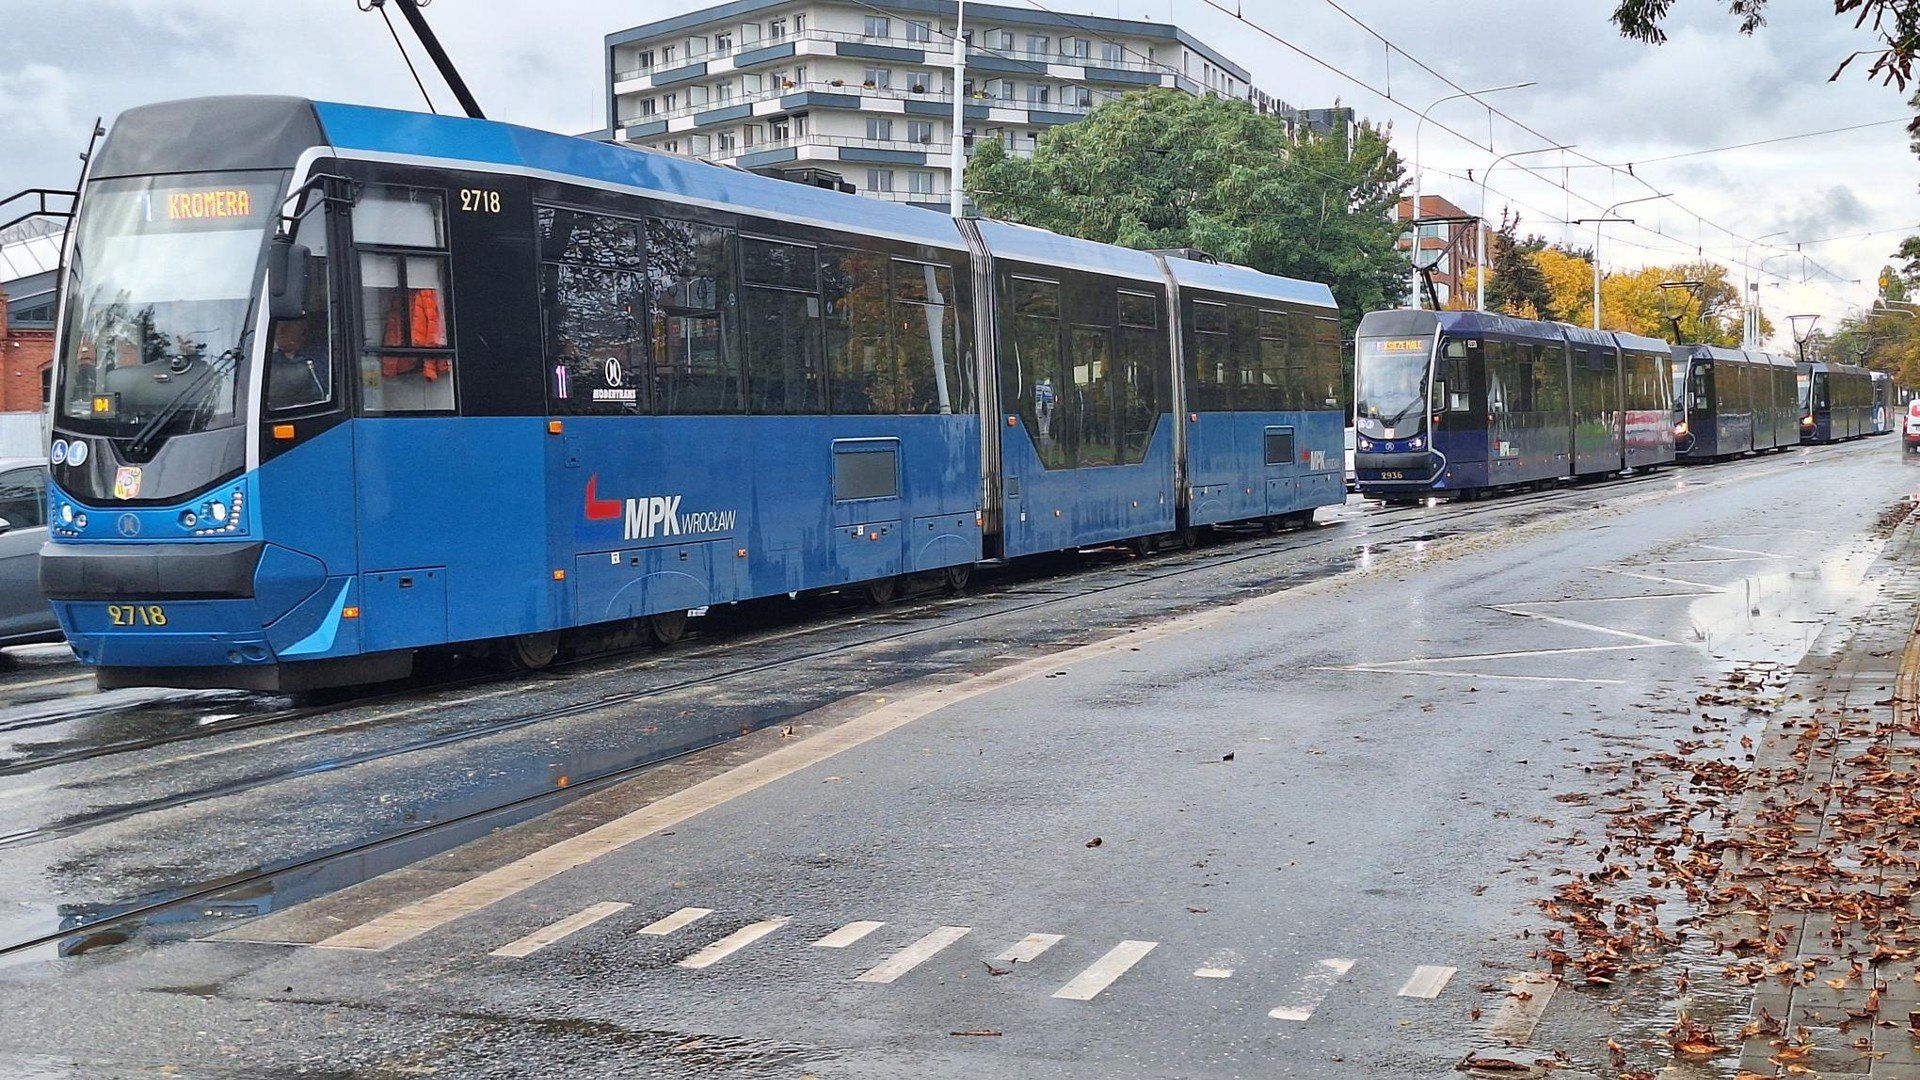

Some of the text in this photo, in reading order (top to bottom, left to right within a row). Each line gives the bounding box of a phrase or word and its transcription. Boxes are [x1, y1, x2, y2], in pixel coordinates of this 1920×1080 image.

[167, 189, 251, 219] KROMERA
[460, 188, 501, 213] 2718
[555, 365, 568, 399] 11
[592, 388, 637, 399] MODERTRANS
[624, 495, 736, 541] MPK WROCŁAW
[108, 605, 167, 626] 2718
